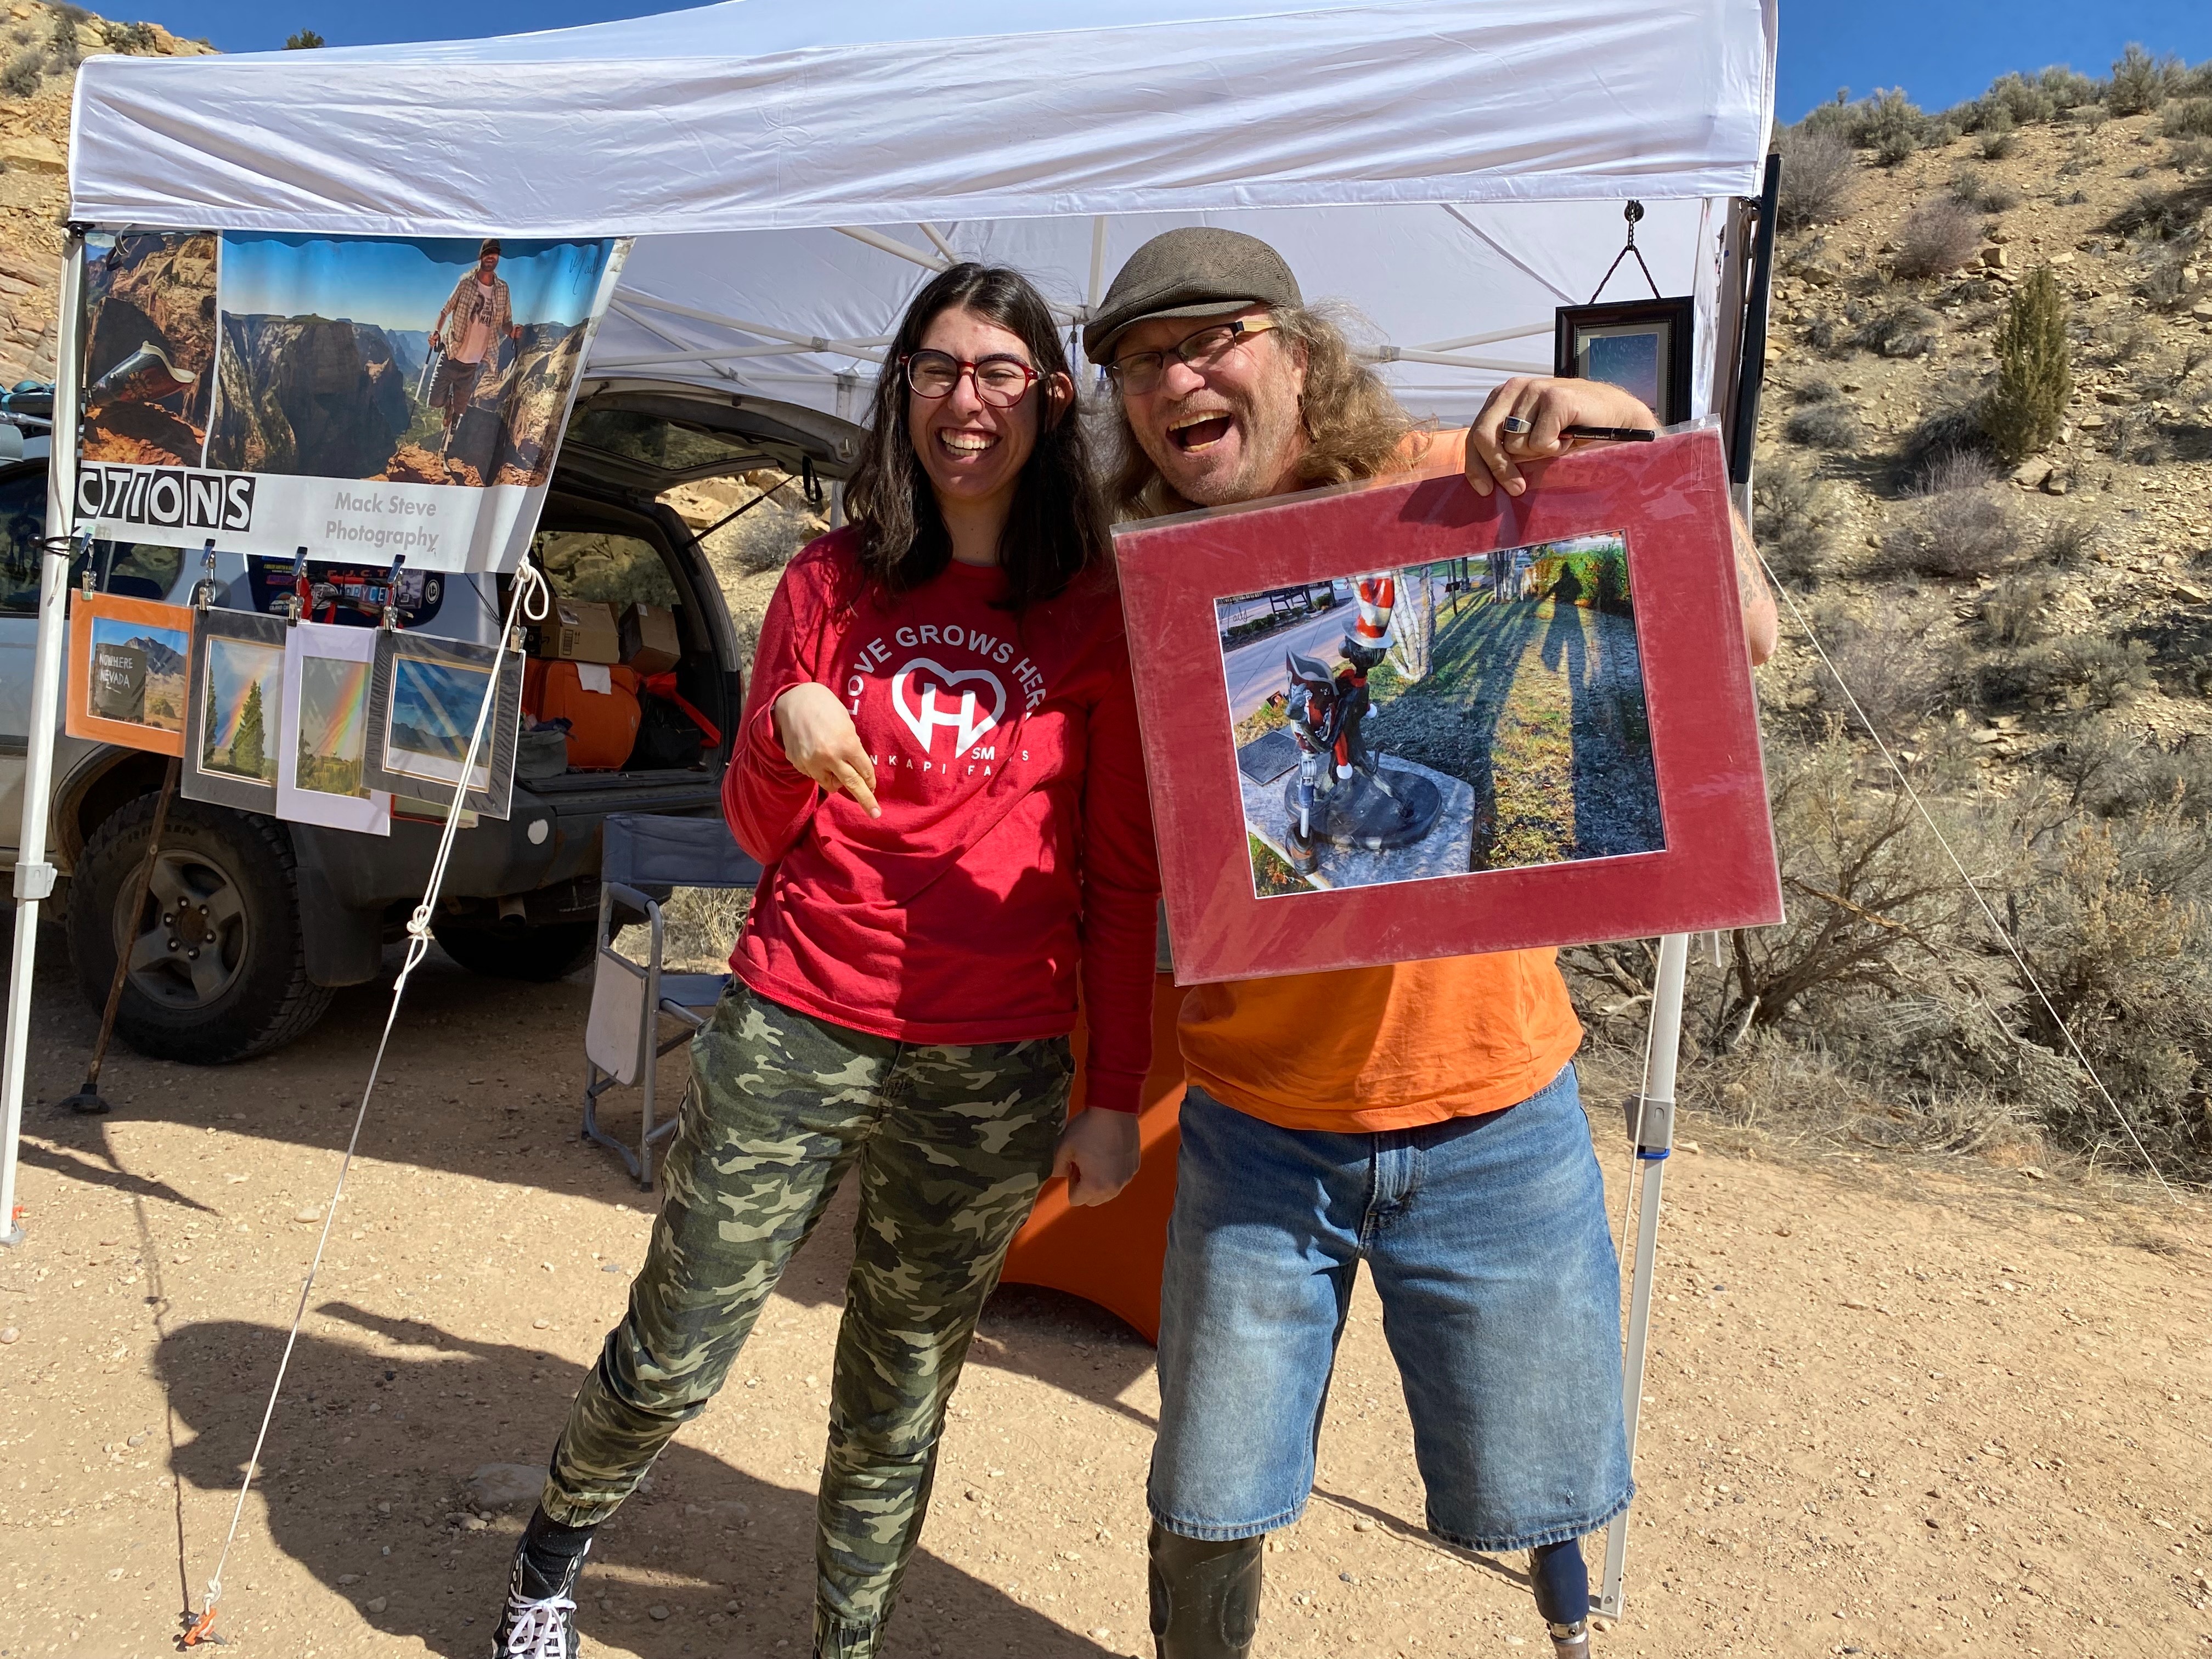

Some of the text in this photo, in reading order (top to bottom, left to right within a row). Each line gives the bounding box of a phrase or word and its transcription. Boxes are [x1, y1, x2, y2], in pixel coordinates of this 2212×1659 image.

[77, 471, 251, 529] CTIONS
[334, 492, 437, 517] Mack Steve
[325, 520, 439, 552] Photography
[99, 652, 133, 670] NOWHERE
[847, 624, 1047, 721] LOVE GROWS HER
[100, 669, 131, 689] NEVADA
[968, 749, 1030, 776] FAS
[970, 746, 995, 761] SM
